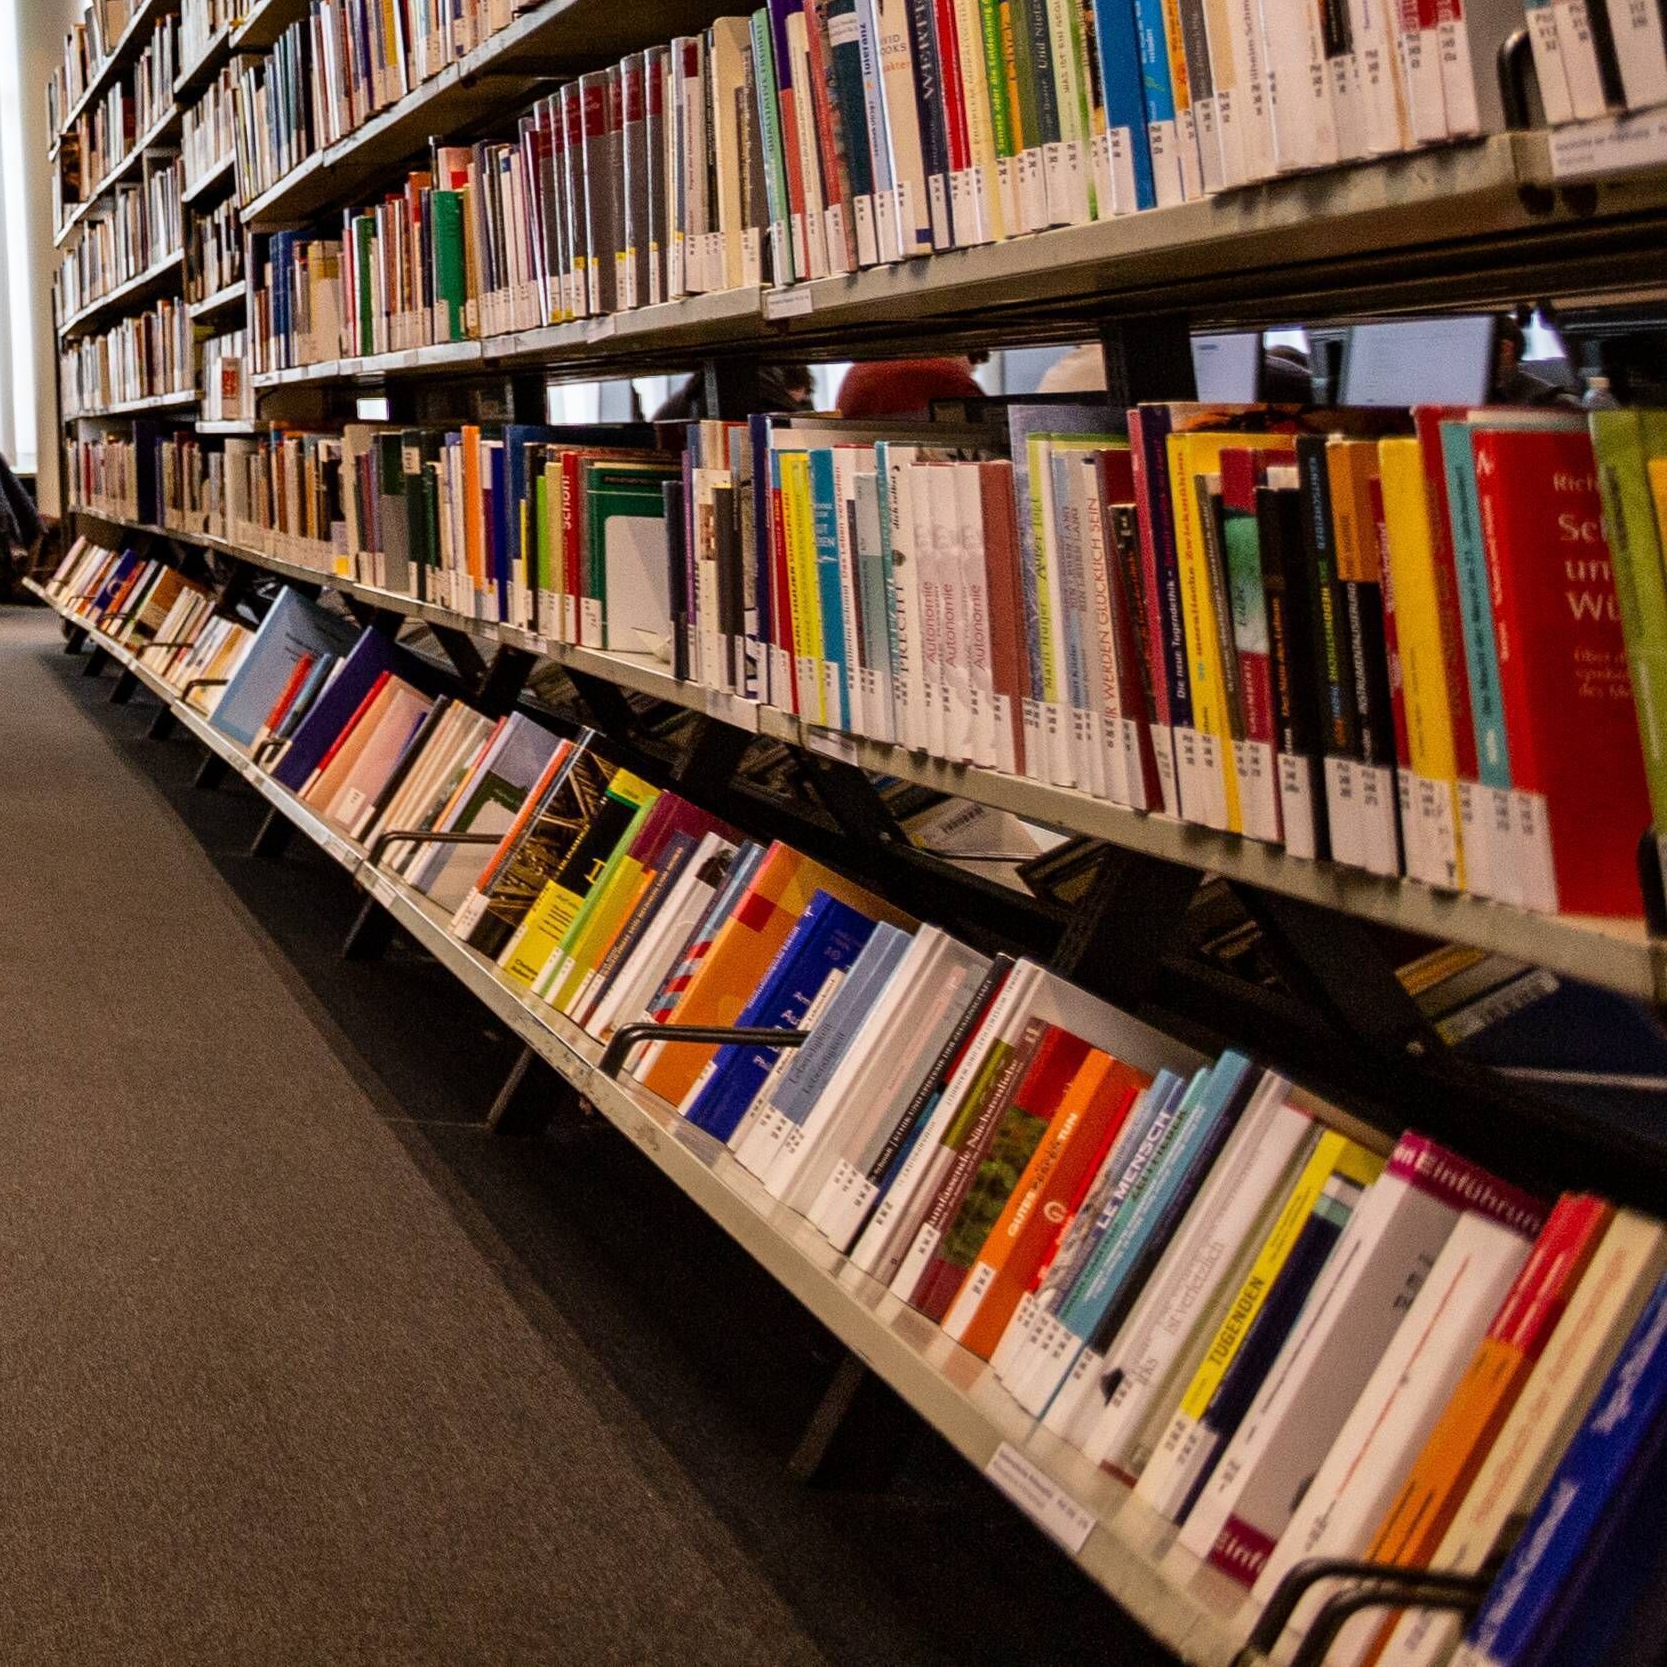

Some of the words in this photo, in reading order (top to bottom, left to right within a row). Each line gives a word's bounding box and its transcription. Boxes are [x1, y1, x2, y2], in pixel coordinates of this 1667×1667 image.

[858, 22, 872, 75] Toleranz
[982, 7, 997, 65] Entdeckung
[1035, 41, 1049, 68] Und
[990, 88, 1002, 110] oder
[992, 113, 1005, 150] Seneca
[887, 475, 900, 503] selbst
[889, 506, 901, 529] dich
[1085, 497, 1099, 532] SEIN
[1172, 450, 1196, 559] Zwickmühlen
[1089, 538, 1108, 624] GLÜCKLICH
[1166, 580, 1181, 646] Tugendethik
[1185, 565, 1205, 655] moralische
[895, 584, 908, 672] PRECHT
[922, 580, 936, 664] Autonomie
[942, 582, 956, 668] Autonomie
[970, 584, 984, 670] Autonomie
[1099, 630, 1115, 698] WERDEN
[1173, 651, 1183, 676] neue
[1175, 680, 1185, 697] Die
[924, 1147, 972, 1225] umfassende
[965, 1057, 1021, 1148] Nächstenliebe
[1004, 1189, 1038, 1237] GUTES
[1057, 1111, 1079, 1142] TUN
[1112, 1109, 1171, 1200] MENSCH
[1172, 1237, 1226, 1316] verletzlich
[1206, 1274, 1266, 1367] TUGENDEN
